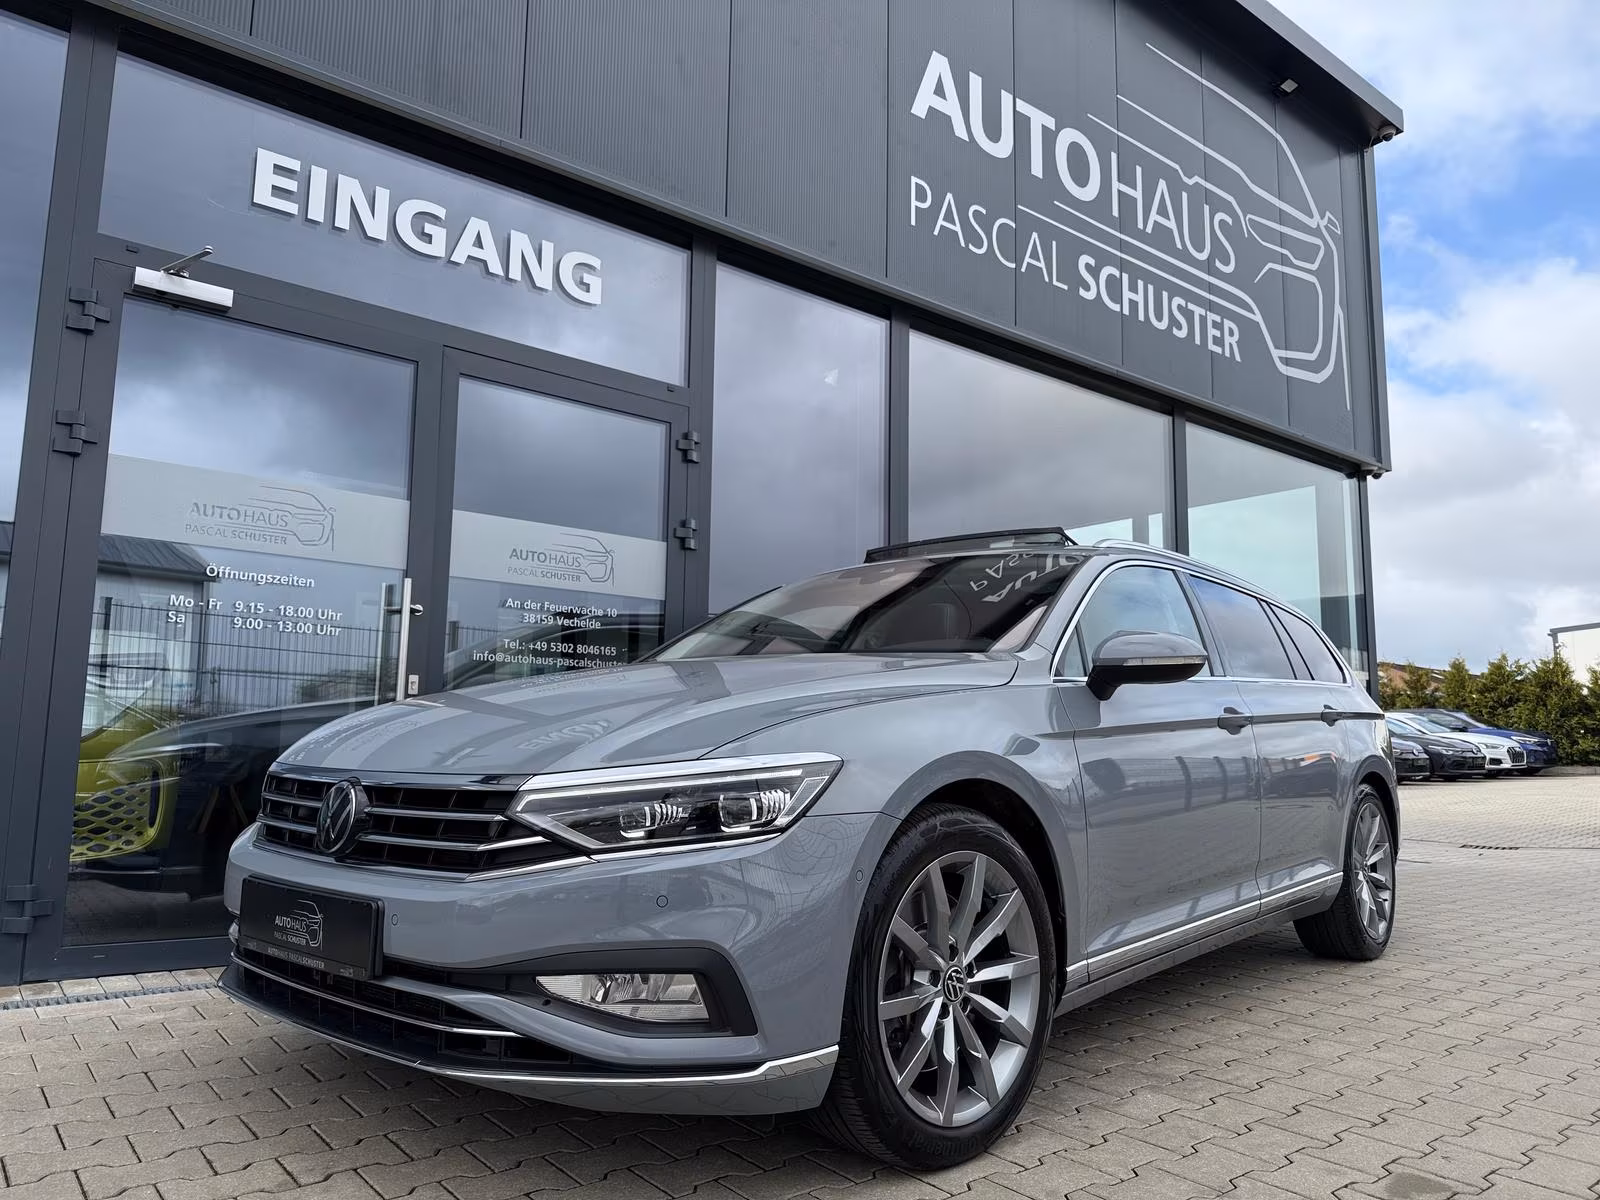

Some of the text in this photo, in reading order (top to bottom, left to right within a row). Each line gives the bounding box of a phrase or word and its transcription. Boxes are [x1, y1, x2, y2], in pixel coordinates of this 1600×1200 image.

[910, 50, 1236, 274] AUTOHAUS
[253, 147, 602, 305] EINGANG
[910, 175, 1242, 362] PASCAL SCHUSTER
[190, 502, 289, 528] AUTOHAUS
[185, 523, 287, 545] PASCAL SCHUSTER
[509, 548, 582, 568] AUTOHAUS
[206, 562, 315, 588] Öffnungszeiten
[507, 566, 582, 582] PASCAL SCHUSTER
[169, 594, 194, 608] Mo
[208, 598, 223, 610] Fr
[234, 600, 264, 614] 9.15
[278, 605, 314, 619] 18.00
[318, 609, 343, 622] Uhr
[506, 598, 618, 618] An der Feuerwache 10
[523, 613, 601, 629] 38159 Vechelde
[167, 611, 186, 624] Sa
[233, 616, 263, 630] 9.00
[277, 620, 313, 634] 13.00
[317, 624, 342, 637] Uhr
[503, 639, 617, 656] Tel.: +49 5302 8046165
